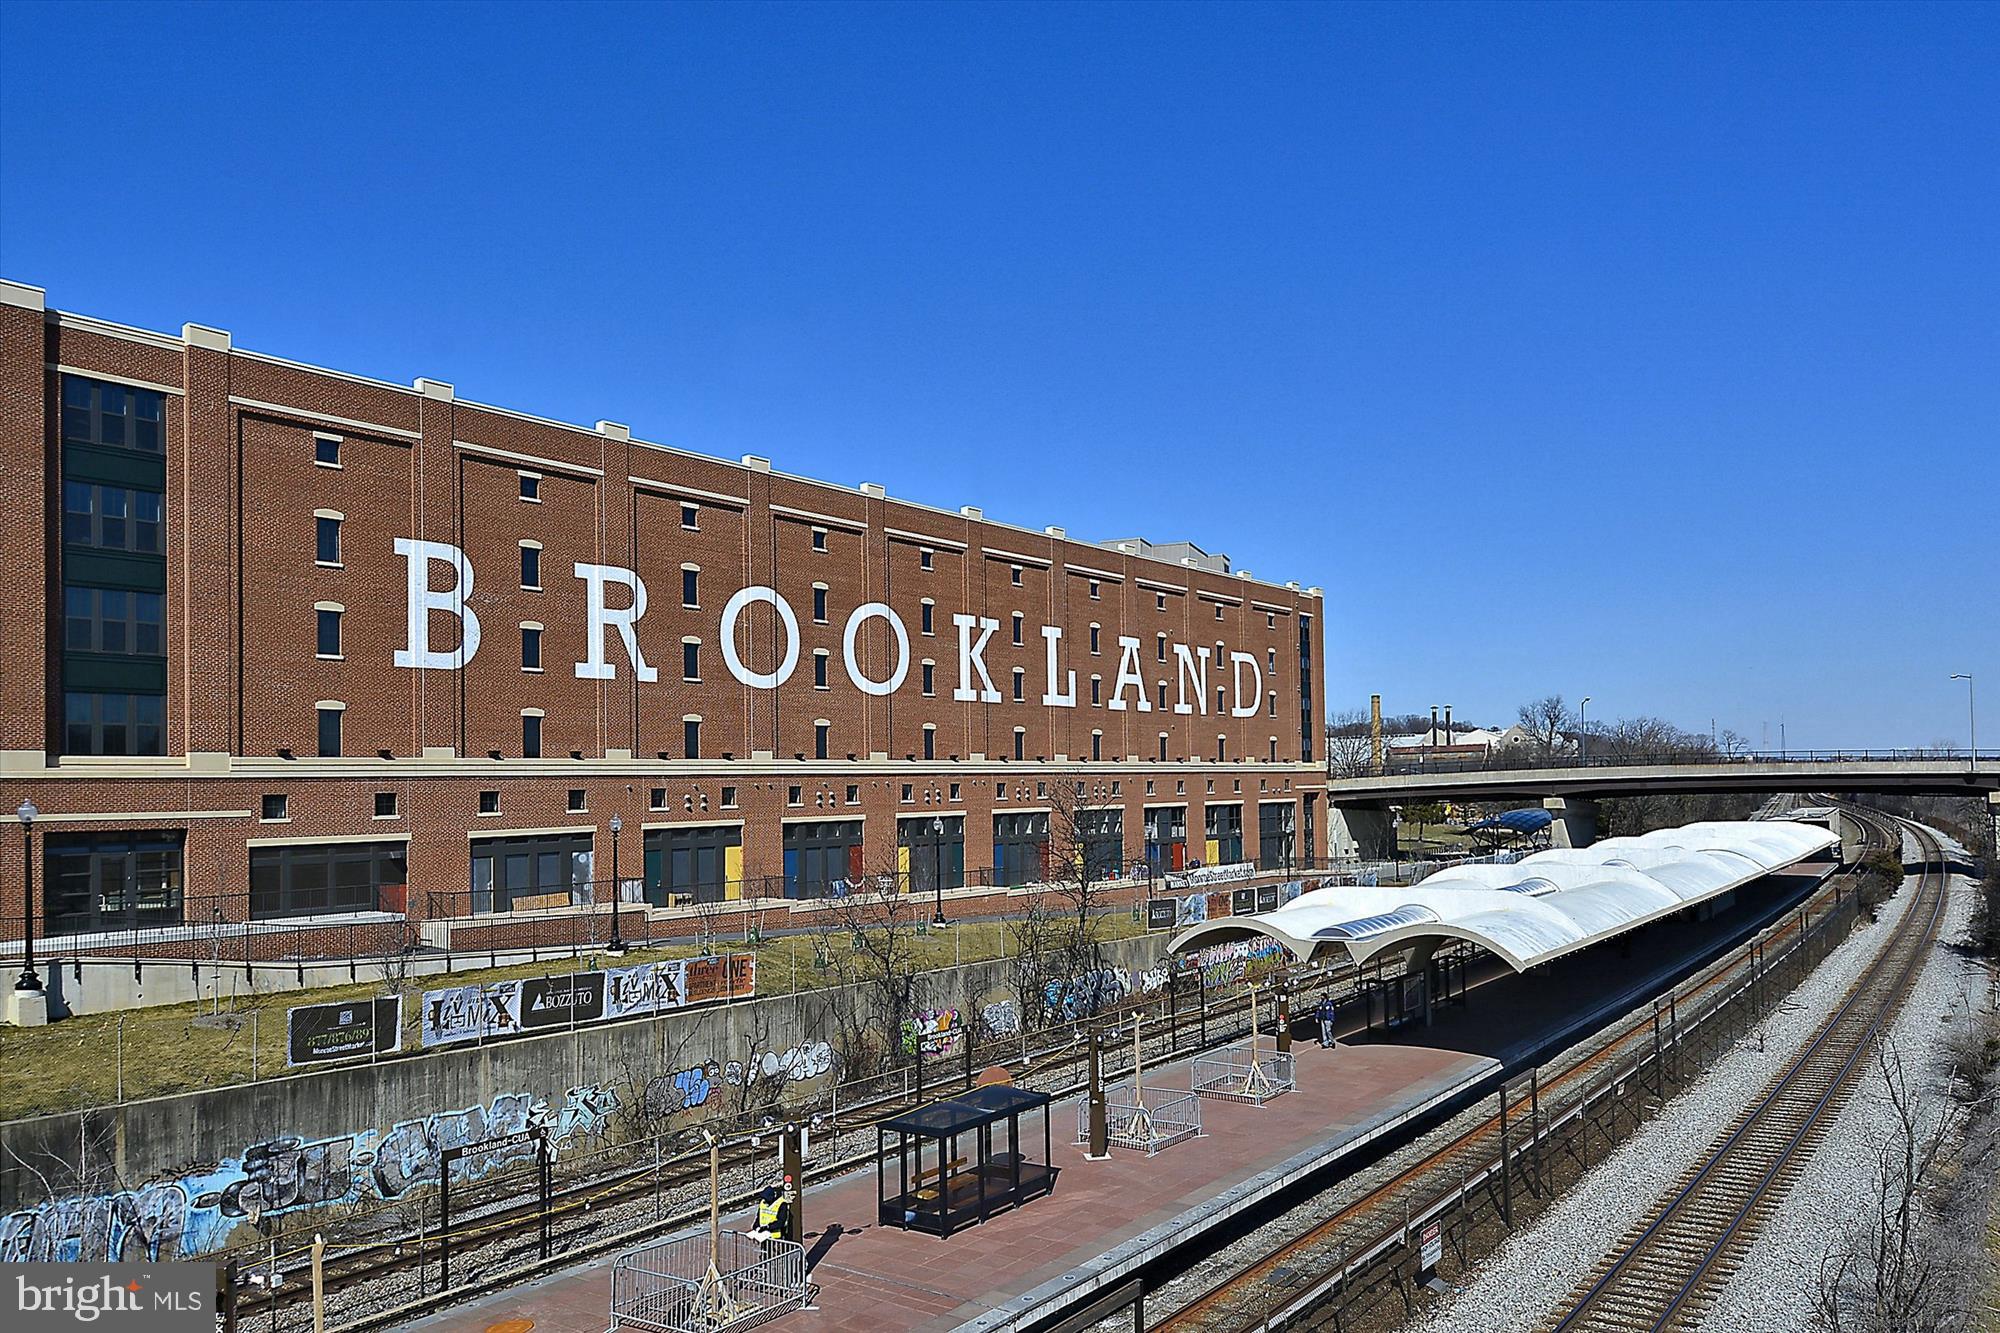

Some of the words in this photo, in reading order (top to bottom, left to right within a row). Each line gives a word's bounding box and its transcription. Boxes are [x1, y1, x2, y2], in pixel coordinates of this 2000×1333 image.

[393, 537, 1263, 717] BROOKLAND
[546, 991, 592, 1008] BOZZUTO
[461, 1132, 531, 1157] Brookland-CUA
